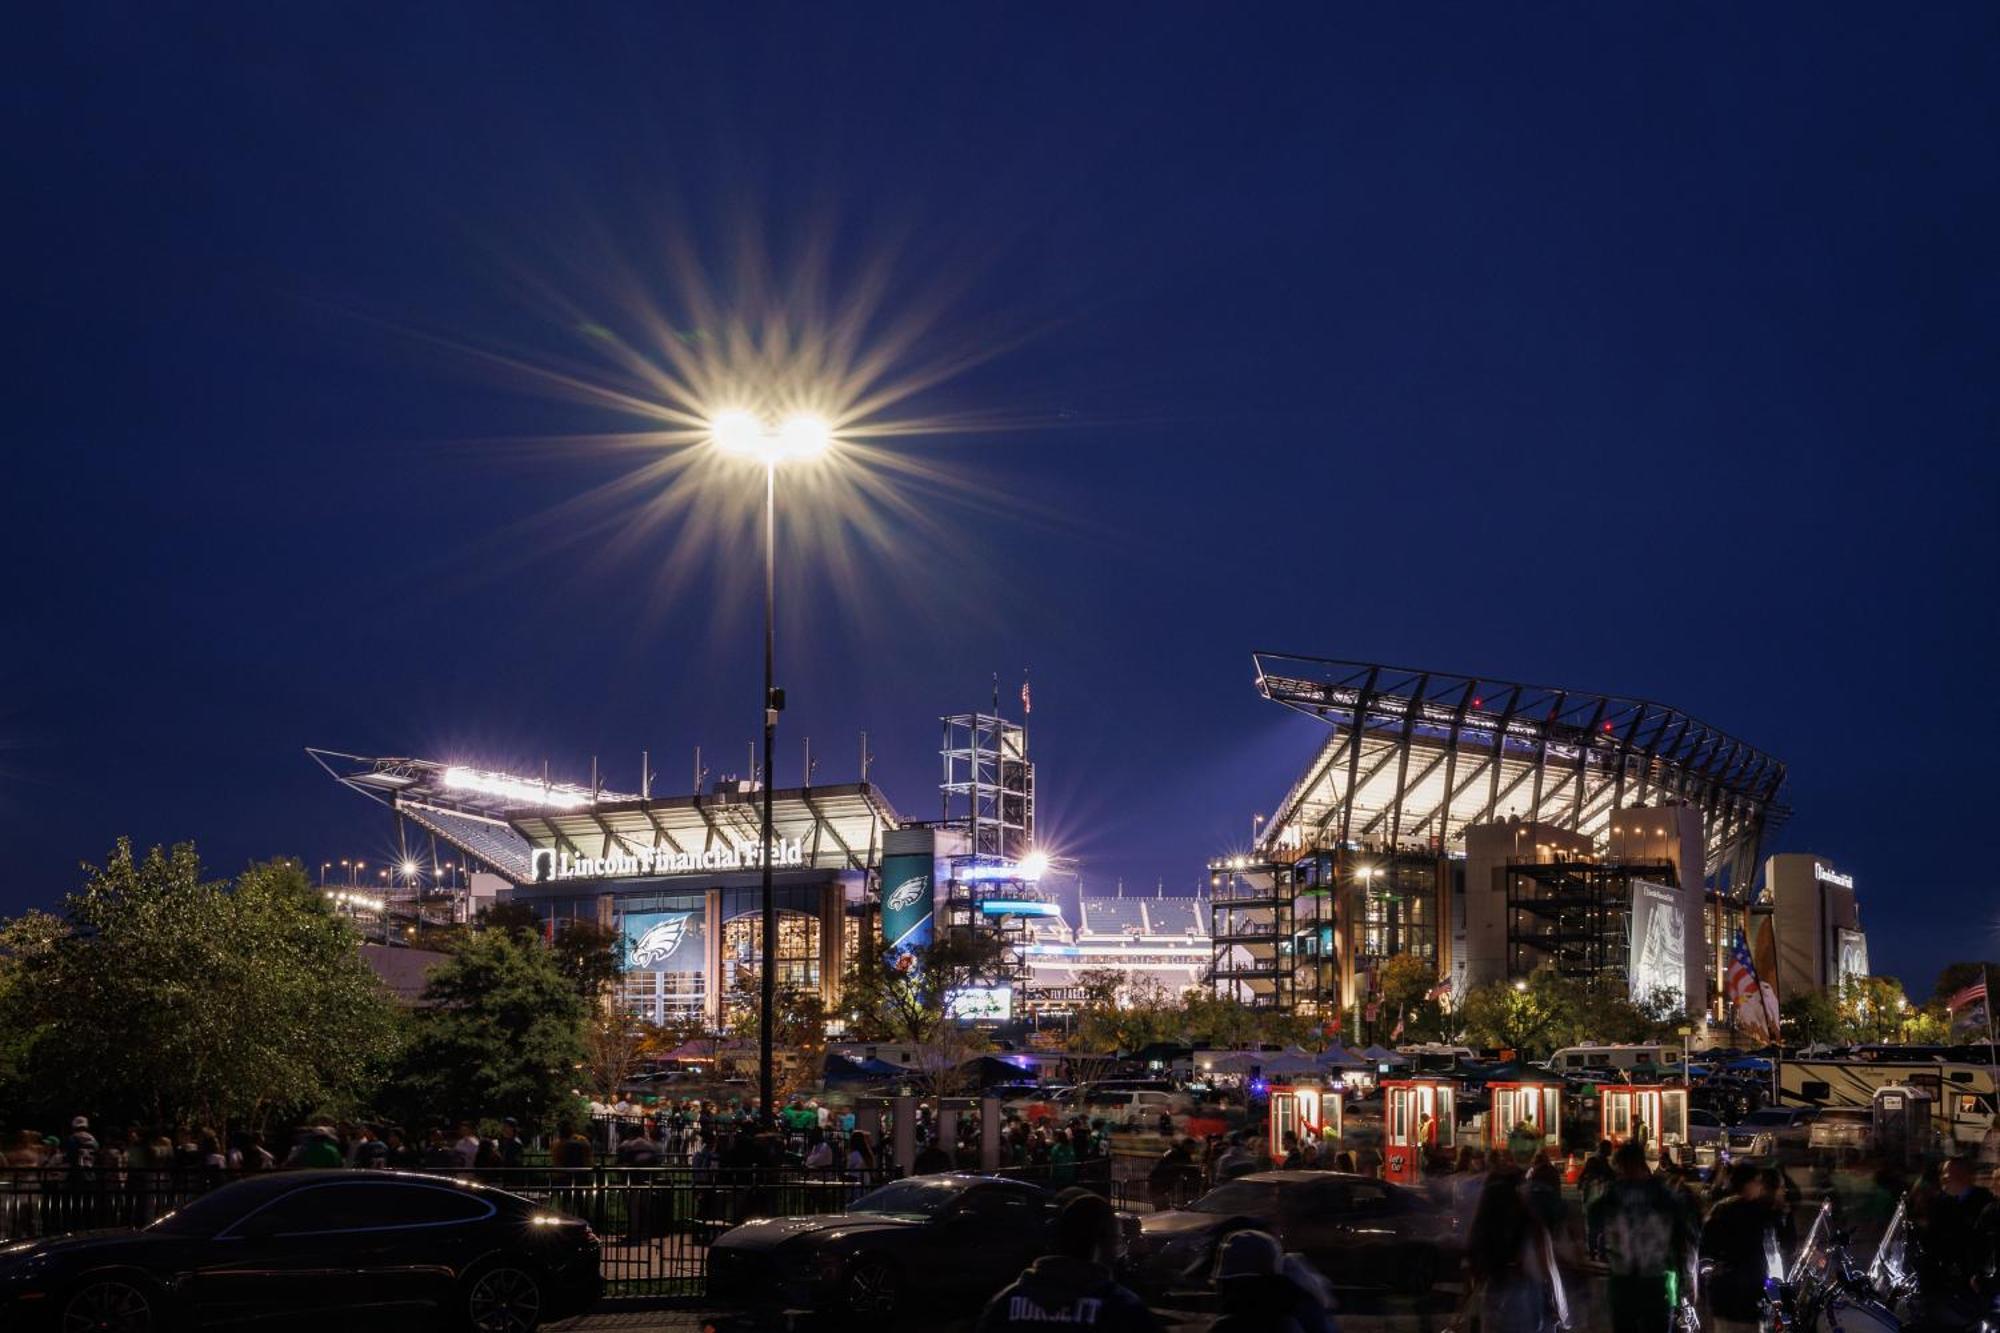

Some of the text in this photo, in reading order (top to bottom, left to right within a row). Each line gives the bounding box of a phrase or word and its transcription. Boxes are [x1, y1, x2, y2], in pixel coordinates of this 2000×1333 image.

[558, 838, 803, 876] Lincoln Financial Field
